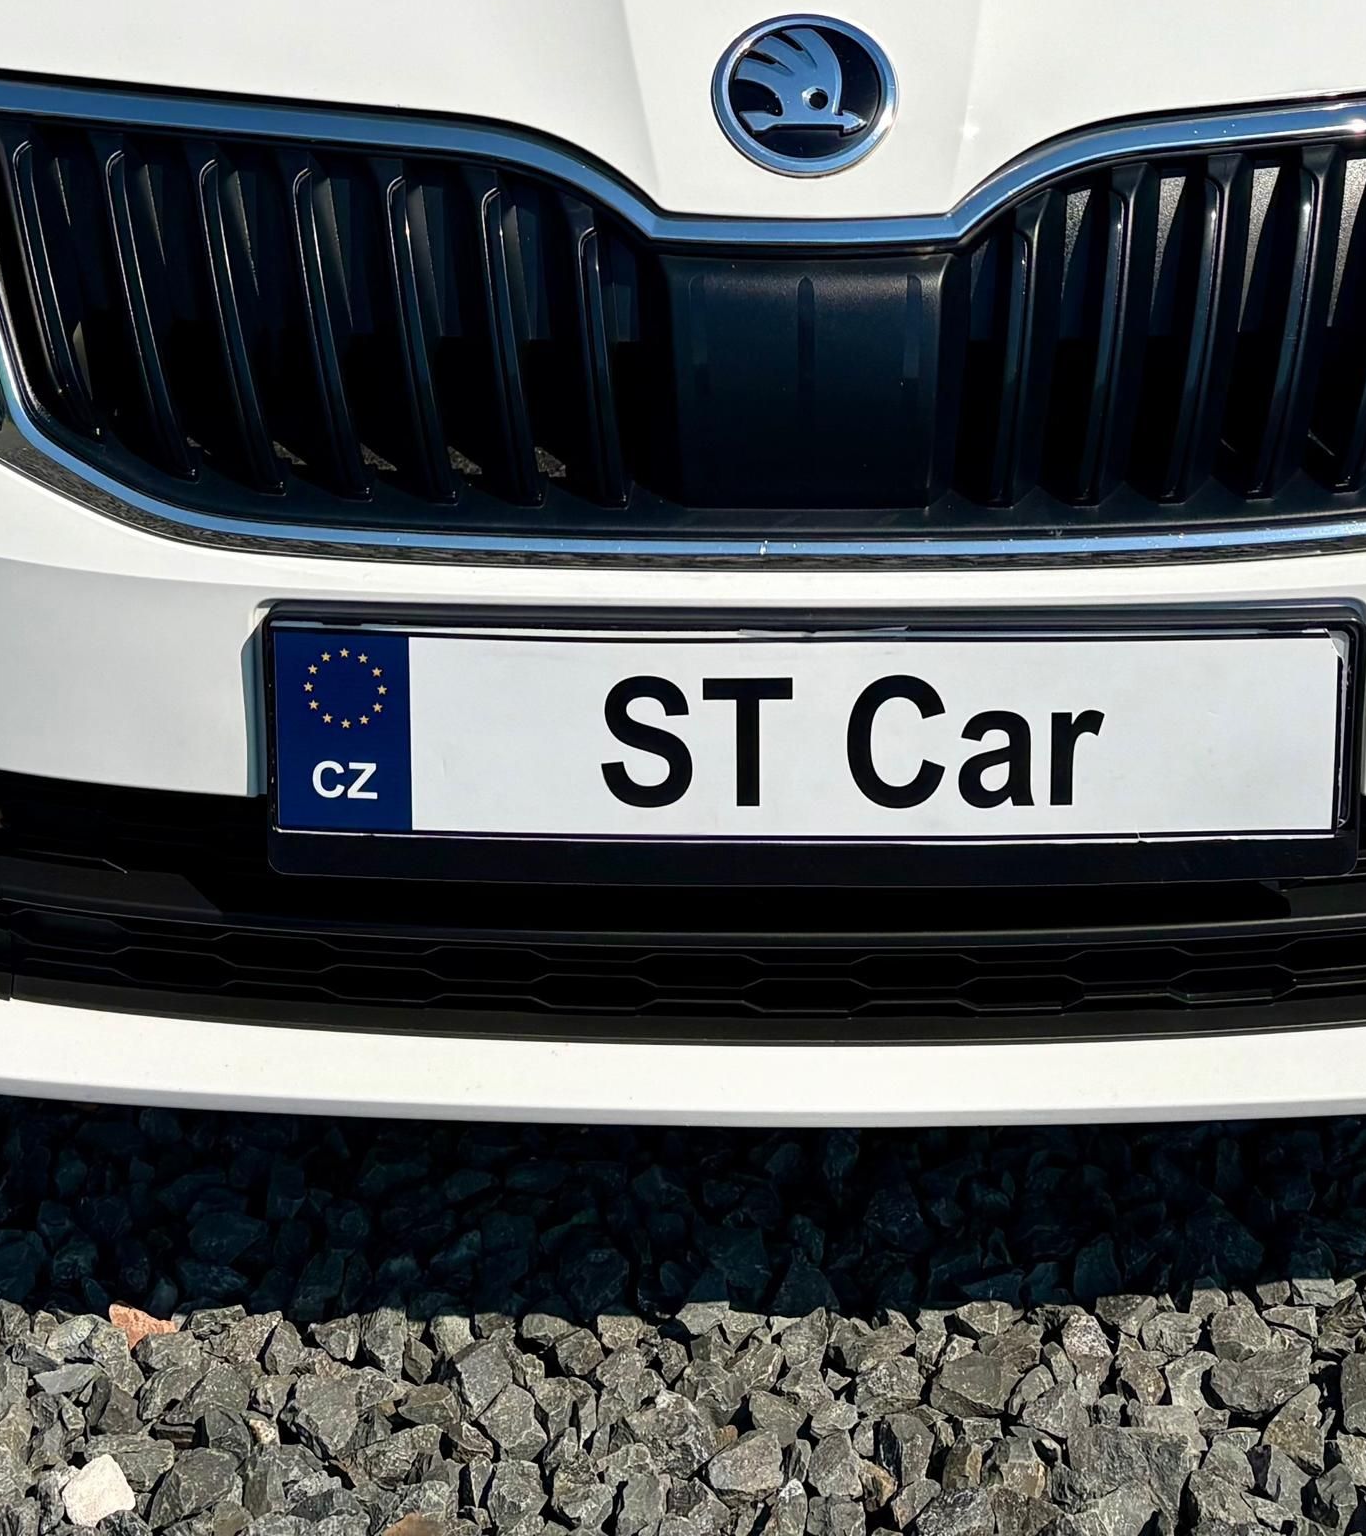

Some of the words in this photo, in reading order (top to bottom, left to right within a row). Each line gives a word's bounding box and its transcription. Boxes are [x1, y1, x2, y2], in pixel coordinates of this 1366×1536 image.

[312, 761, 378, 799] CZ
[601, 675, 793, 808] ST
[847, 675, 1105, 809] Car
